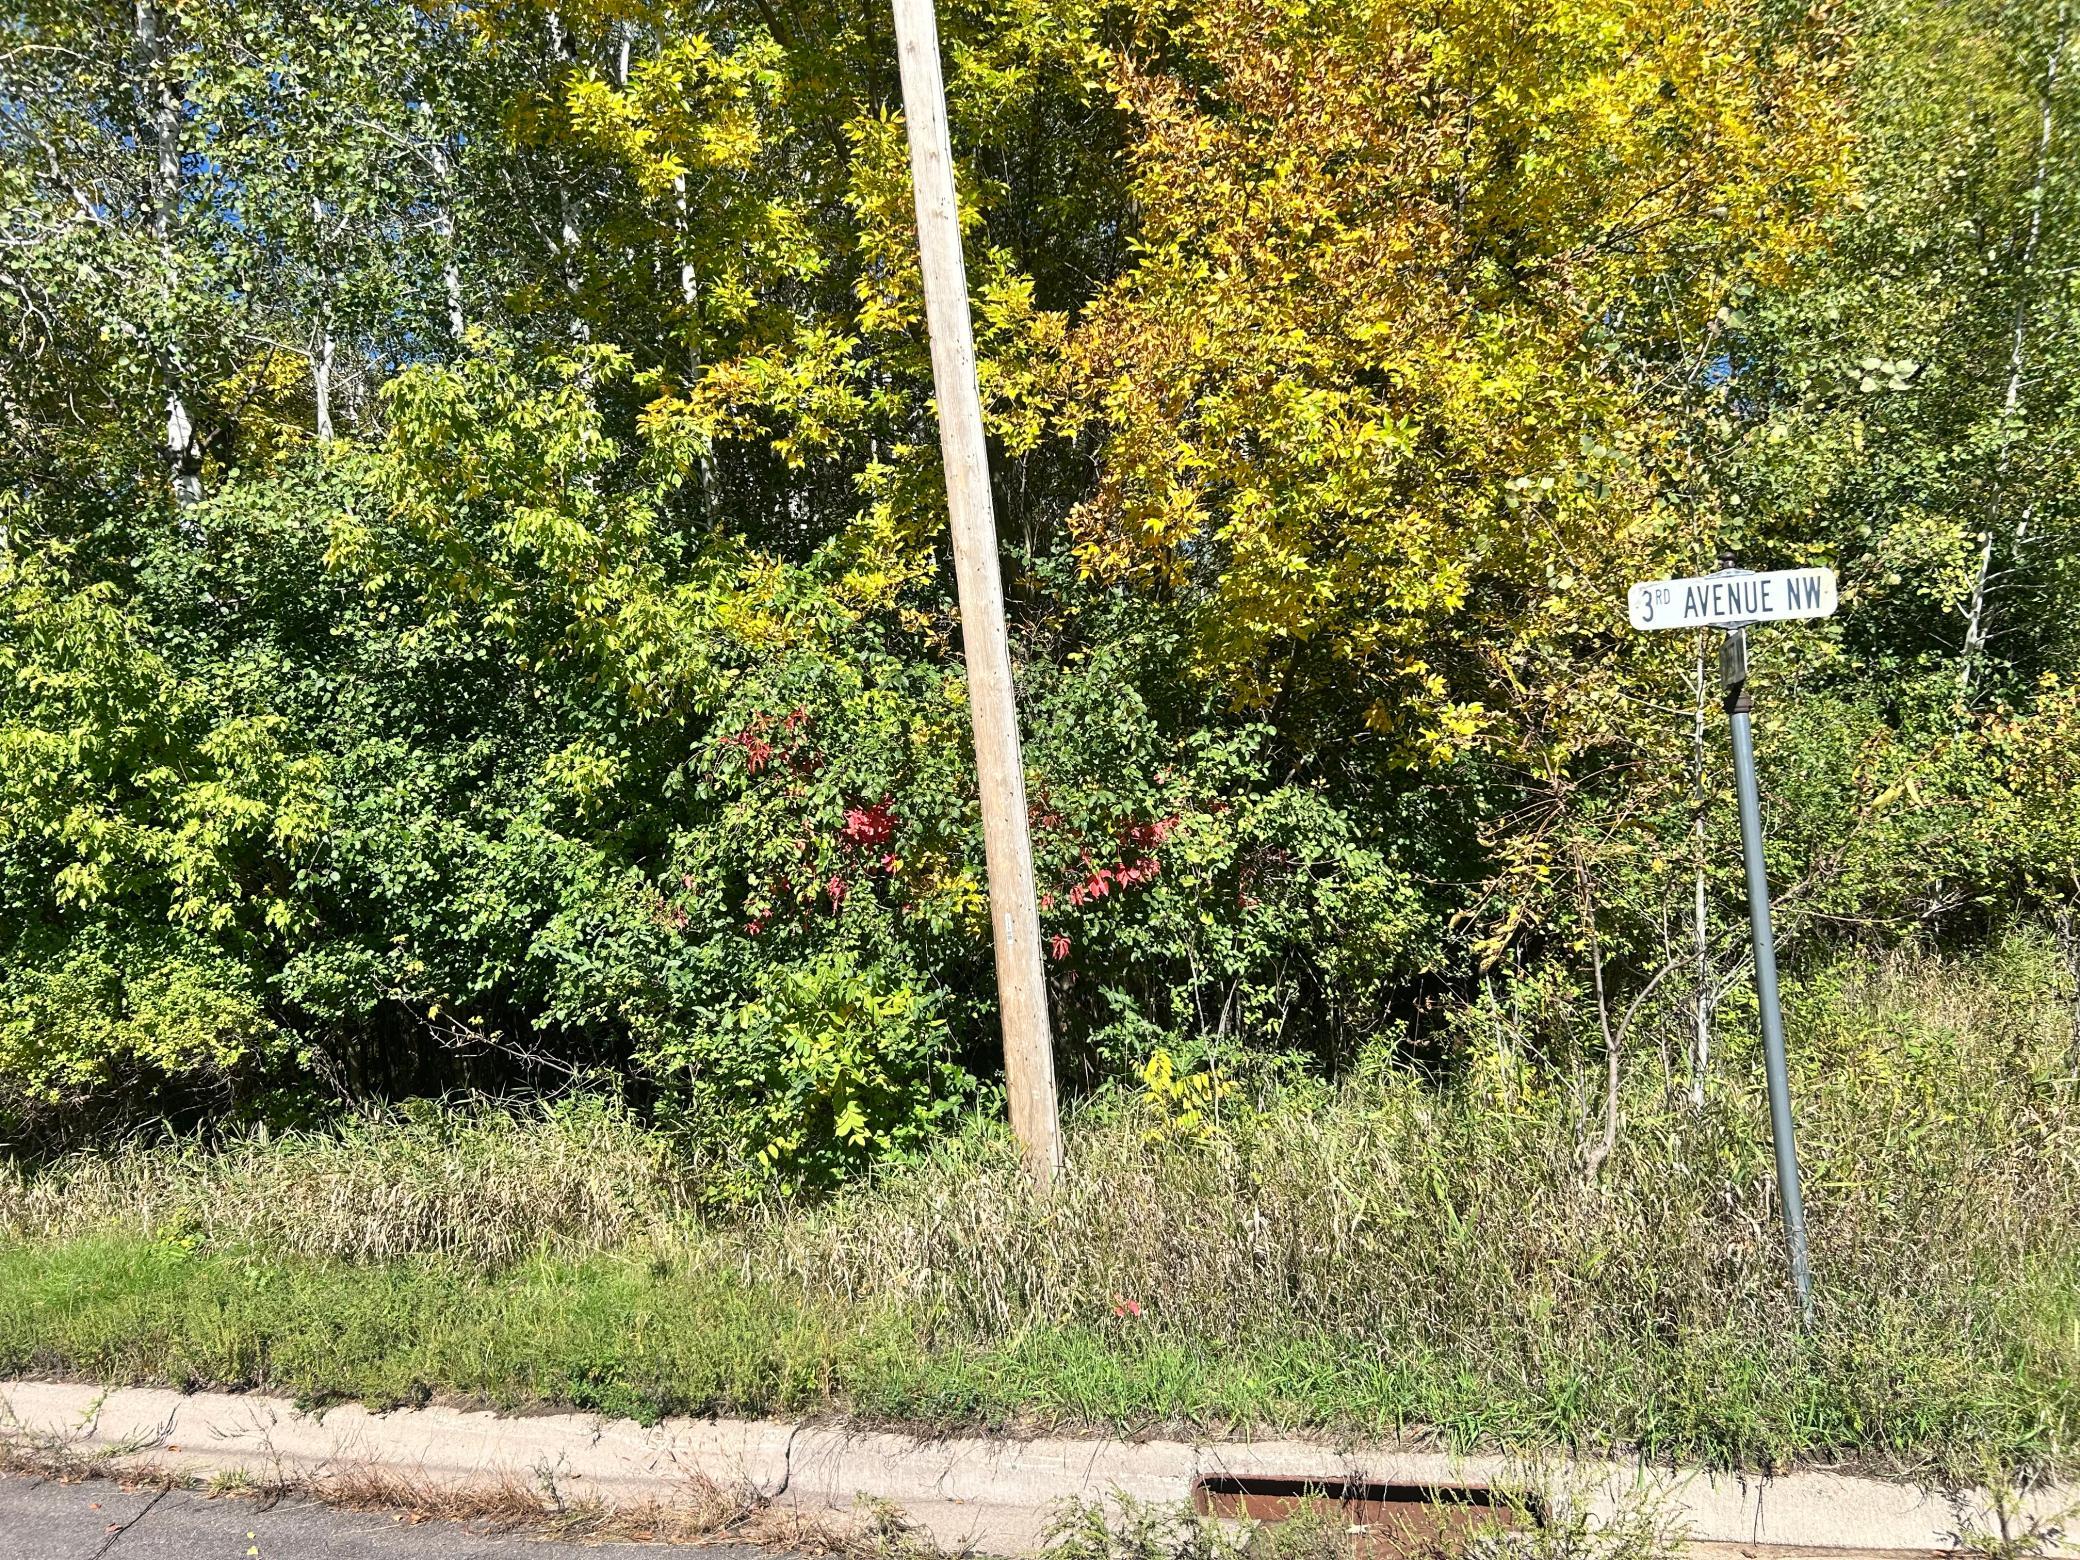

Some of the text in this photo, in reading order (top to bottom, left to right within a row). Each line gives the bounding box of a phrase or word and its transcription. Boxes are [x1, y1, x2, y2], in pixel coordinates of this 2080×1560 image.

[1642, 576, 1821, 622] 3RD AVENUE NW
